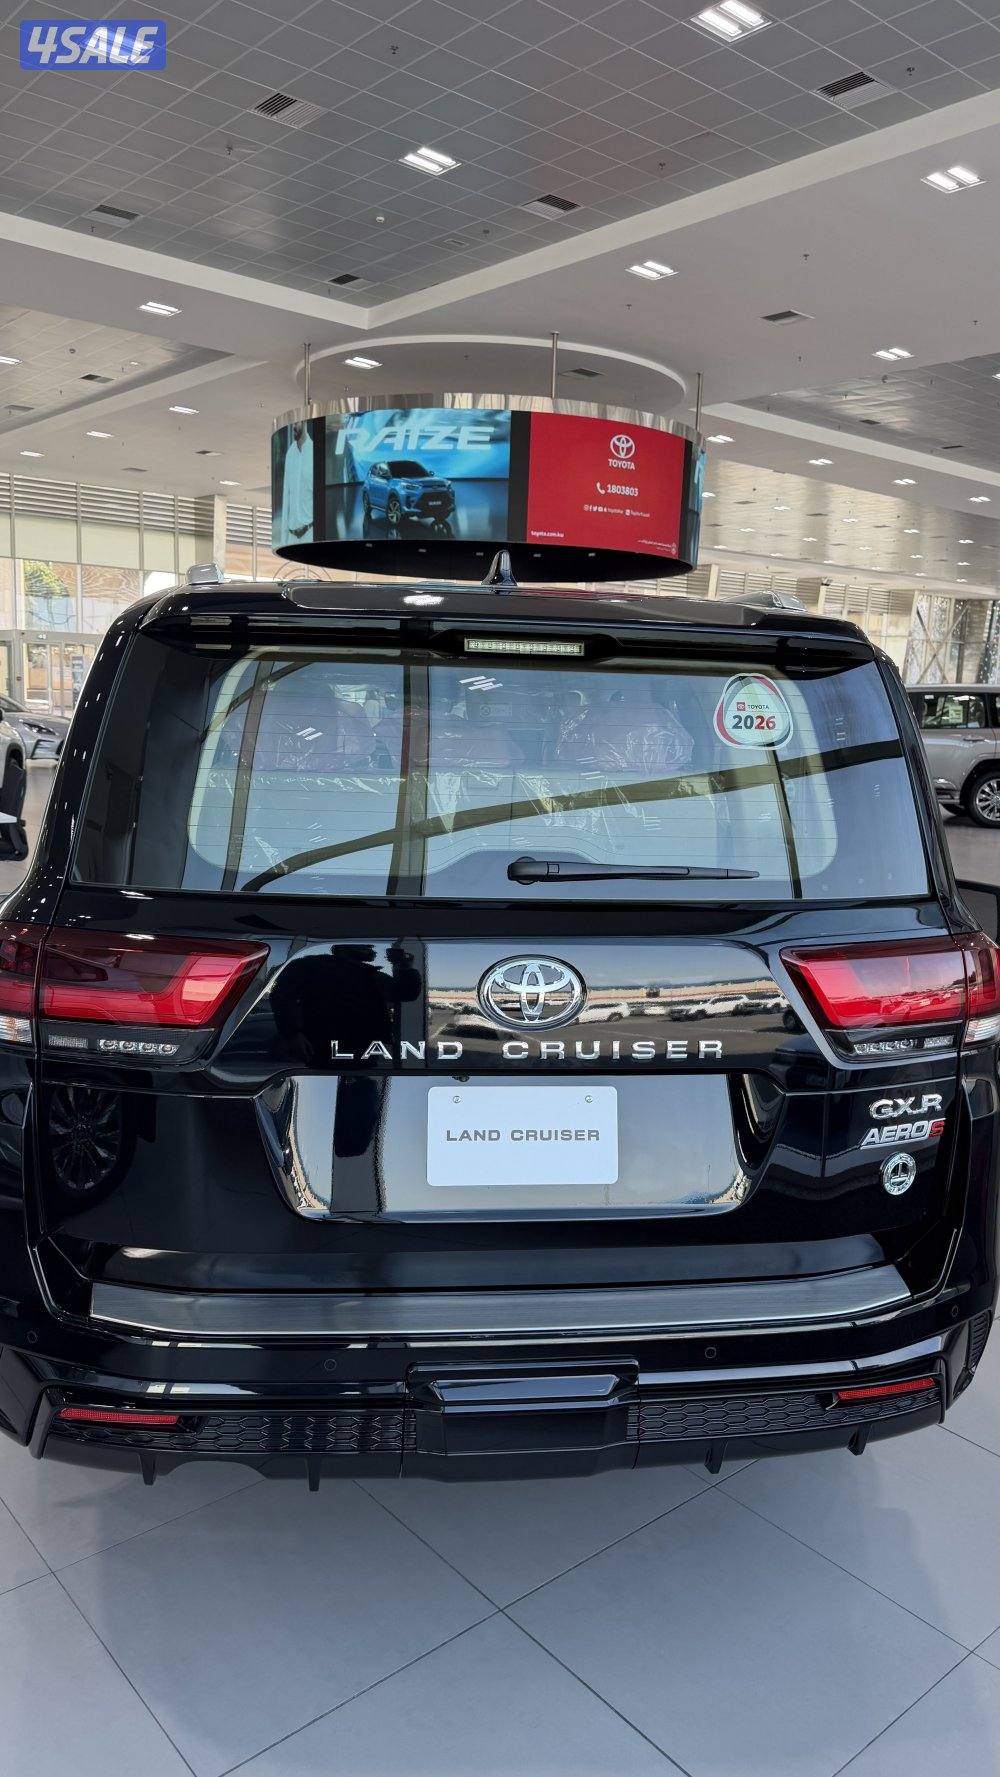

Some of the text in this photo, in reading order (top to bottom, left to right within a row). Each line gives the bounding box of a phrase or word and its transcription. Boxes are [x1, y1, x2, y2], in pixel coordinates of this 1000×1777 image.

[334, 425, 495, 455] RAIZE
[608, 458, 636, 470] TOYOTA
[606, 484, 639, 497] 1803803
[732, 715, 776, 731] 2026
[331, 1039, 724, 1060] LAND CRUISER
[869, 1093, 943, 1119] GXR
[446, 1129, 600, 1142] LAND CRUISER
